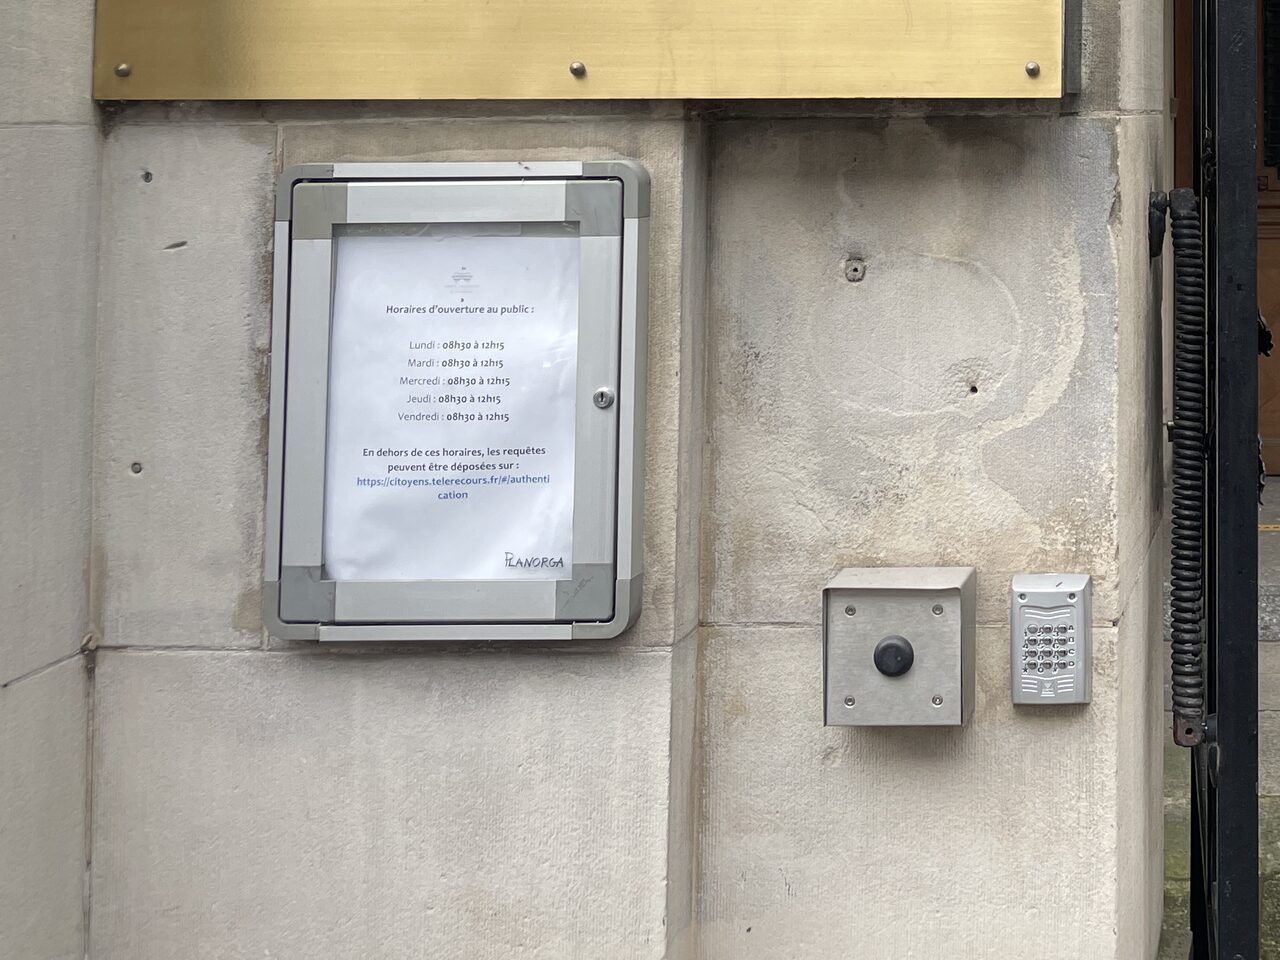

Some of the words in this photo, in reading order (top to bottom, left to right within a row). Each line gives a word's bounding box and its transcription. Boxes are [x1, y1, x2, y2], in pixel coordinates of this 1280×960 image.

[386, 305, 427, 314] Horaires
[428, 305, 485, 314] d'ouverture
[500, 305, 529, 316] public
[409, 341, 435, 350] Lundi
[442, 341, 472, 351] 08h30
[481, 341, 505, 351] 12h15
[407, 359, 435, 368] Mardi
[441, 359, 471, 369] 08h30
[480, 358, 504, 368] 12h15
[399, 377, 441, 386] Mercredi
[447, 377, 477, 387] 08h30
[486, 376, 510, 387] 12h15
[406, 395, 432, 404] Jeudi
[438, 395, 467, 405] 08h30
[477, 394, 501, 404] 12h15
[398, 413, 440, 422] Vendredi
[446, 412, 475, 423] 08h30
[485, 412, 510, 422] 12h15
[363, 448, 375, 456] En
[377, 447, 409, 457] dehors
[411, 448, 423, 456] de
[443, 448, 485, 458] horaires,
[487, 447, 501, 456] les
[503, 447, 546, 457] requêtes
[387, 463, 427, 473] peuvent
[429, 462, 449, 471] être
[451, 462, 497, 473] déposées
[357, 474, 550, 488] https://citoyens.telerecours.fr/#/authenti
[437, 490, 469, 500] cation
[505, 551, 564, 568] PLANORGA
